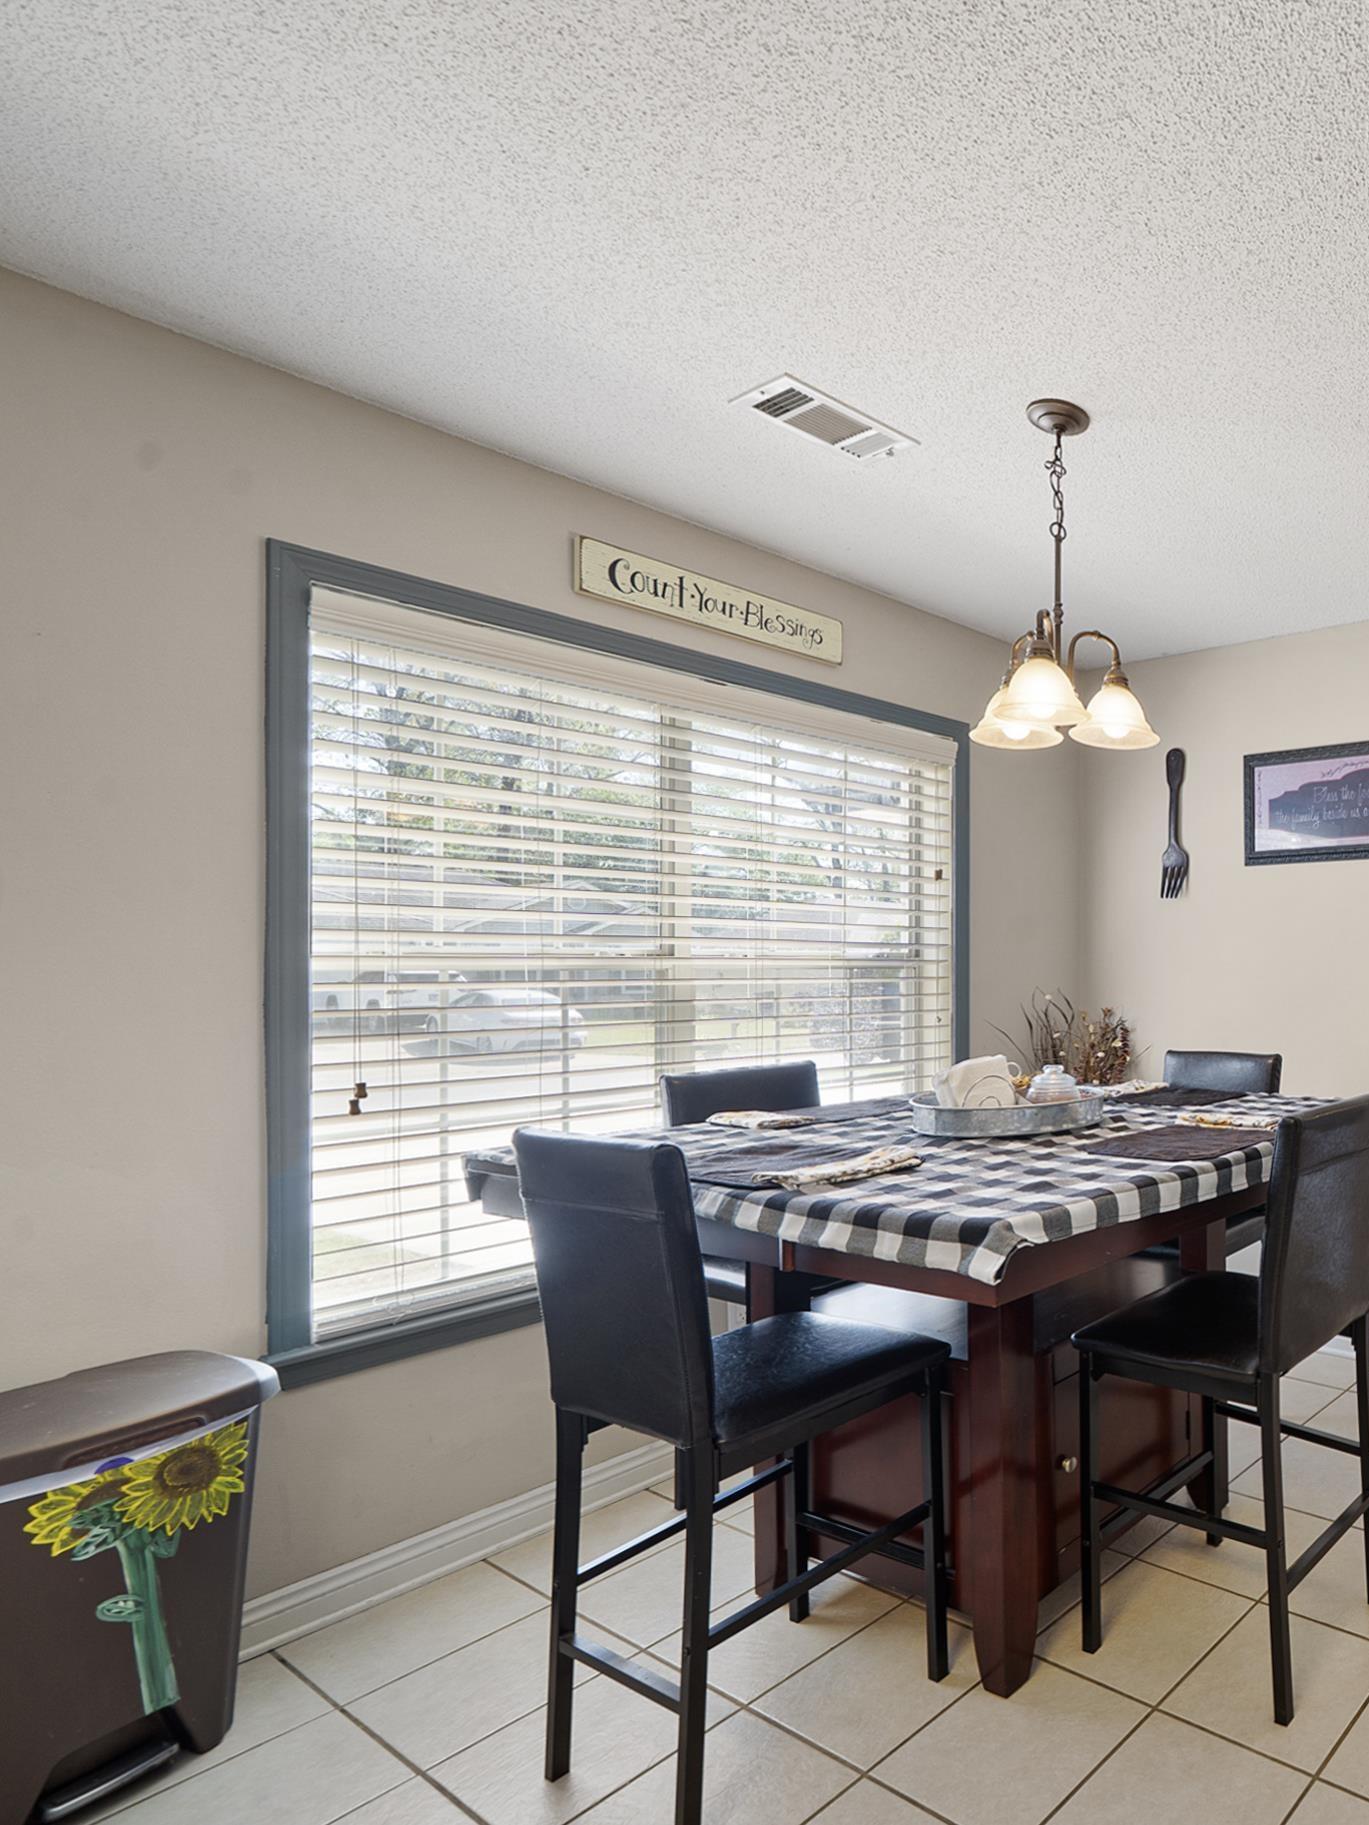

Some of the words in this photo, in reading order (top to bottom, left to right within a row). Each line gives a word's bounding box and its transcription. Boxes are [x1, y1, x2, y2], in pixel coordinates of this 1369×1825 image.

[607, 557, 685, 608] Count
[692, 582, 739, 619] Your
[743, 600, 824, 650] Blessings
[1313, 786, 1339, 804] Bless
[1341, 784, 1355, 801] the
